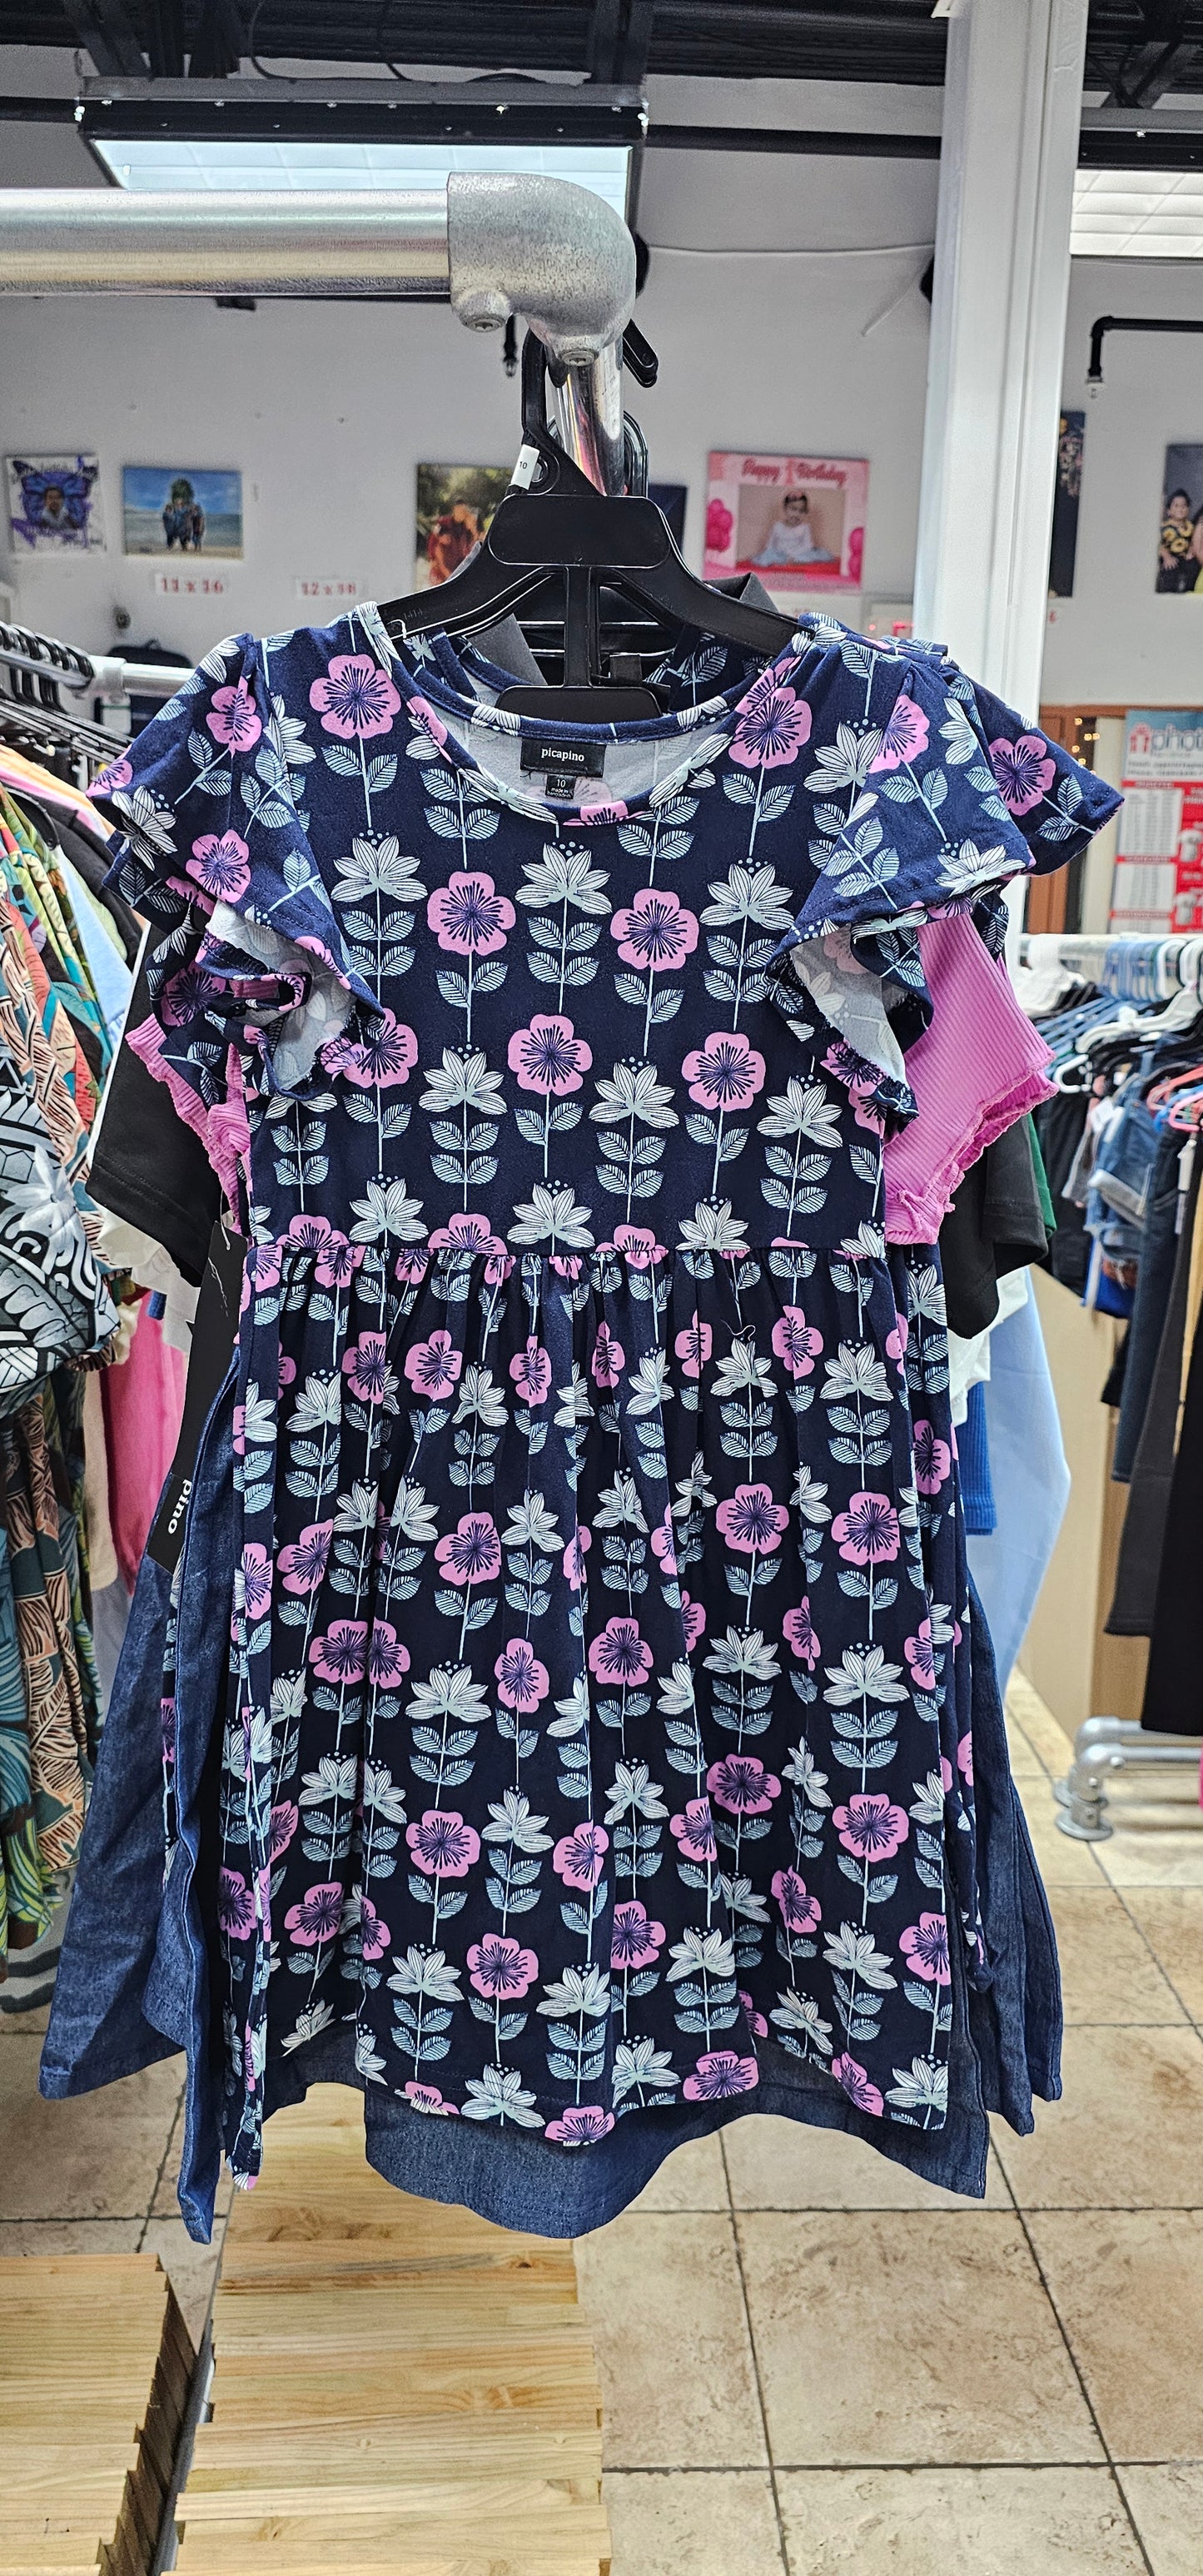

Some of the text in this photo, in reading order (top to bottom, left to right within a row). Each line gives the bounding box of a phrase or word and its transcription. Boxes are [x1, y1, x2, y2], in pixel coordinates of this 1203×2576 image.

[519, 460, 528, 470] 10
[541, 748, 584, 762] picapino
[557, 778, 566, 788] 10
[168, 1479, 192, 1534] pino
